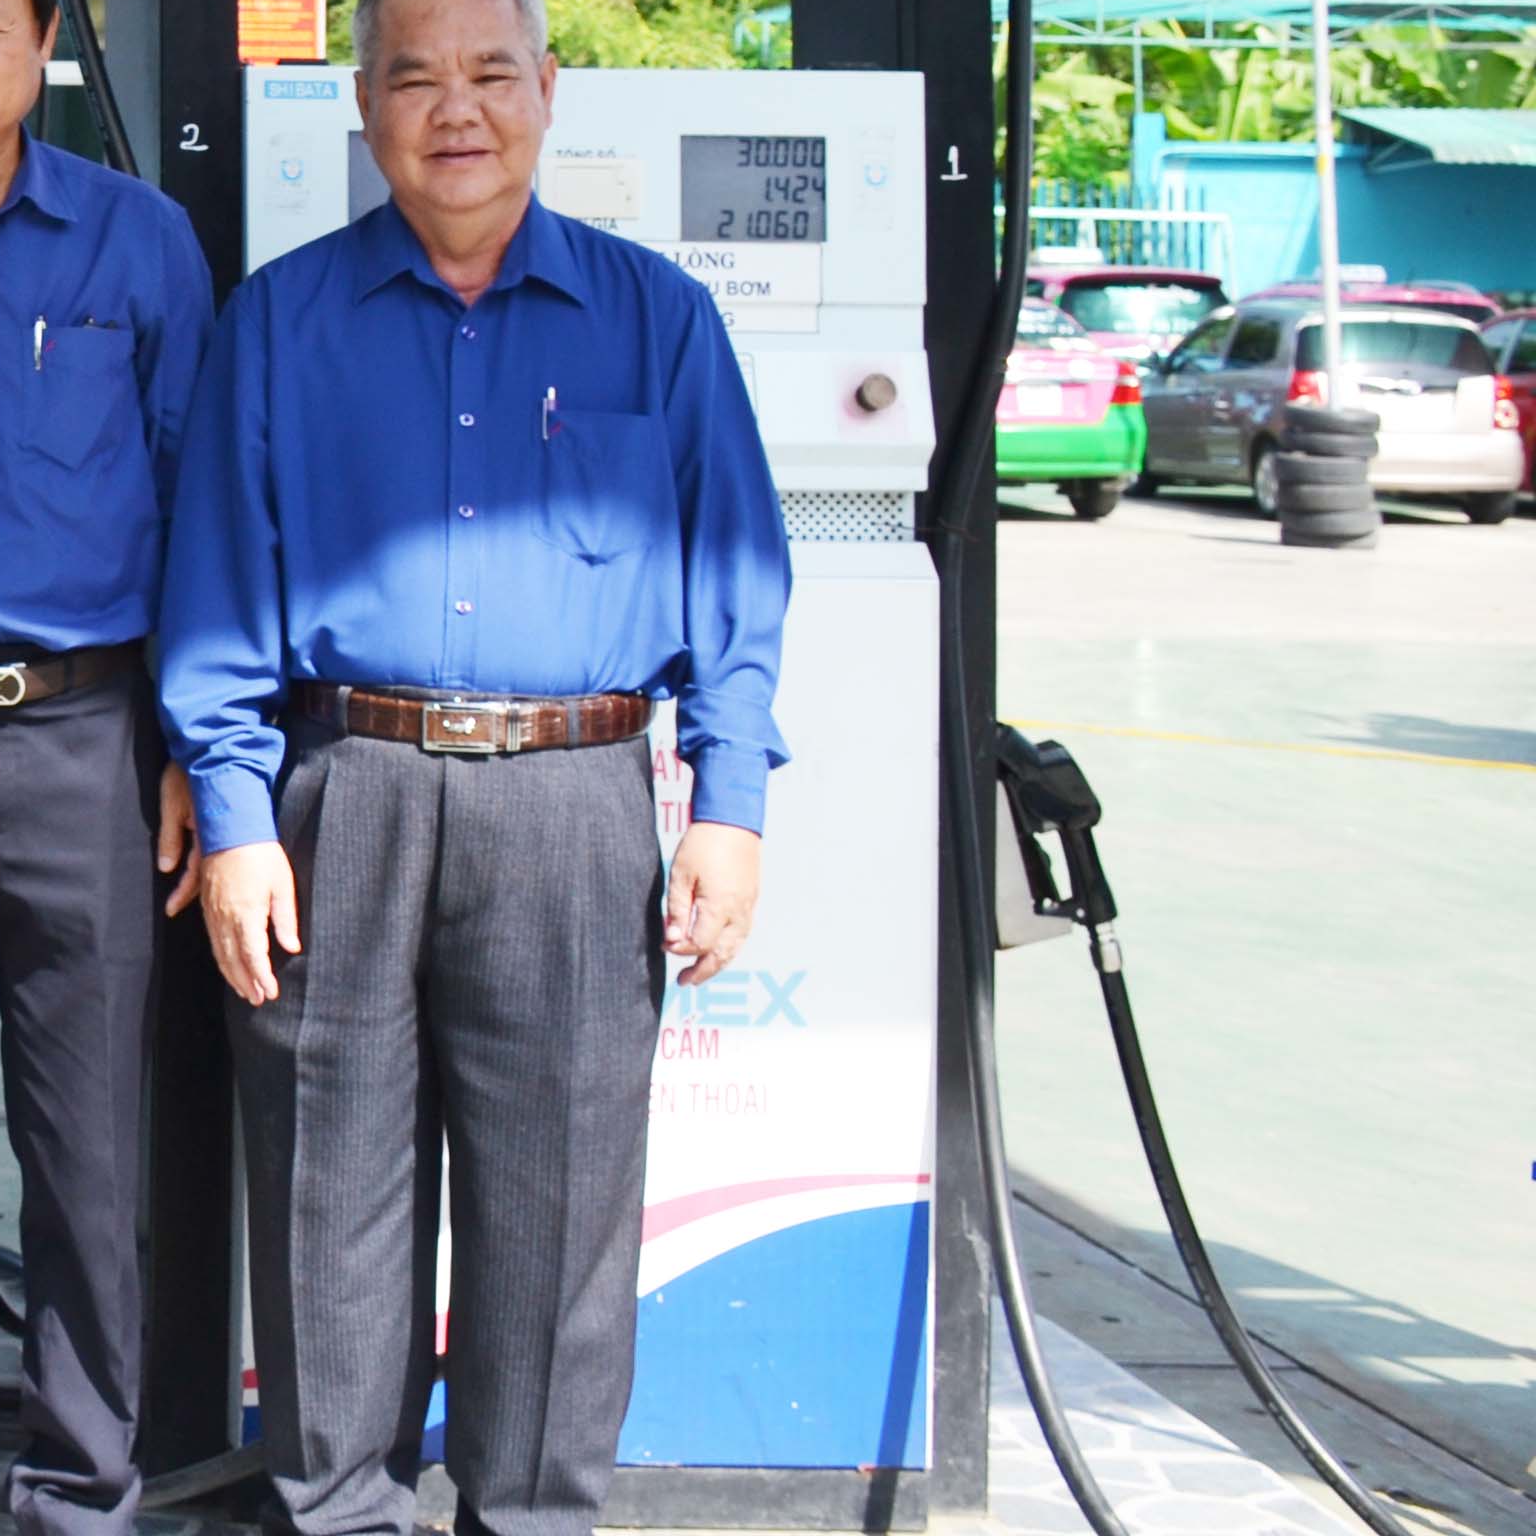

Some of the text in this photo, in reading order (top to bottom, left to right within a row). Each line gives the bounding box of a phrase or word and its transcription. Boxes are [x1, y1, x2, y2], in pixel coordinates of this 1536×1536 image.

[180, 123, 209, 152] 2
[940, 145, 968, 181] 1
[726, 279, 772, 296] BƠM
[660, 1014, 720, 1060] CẤM
